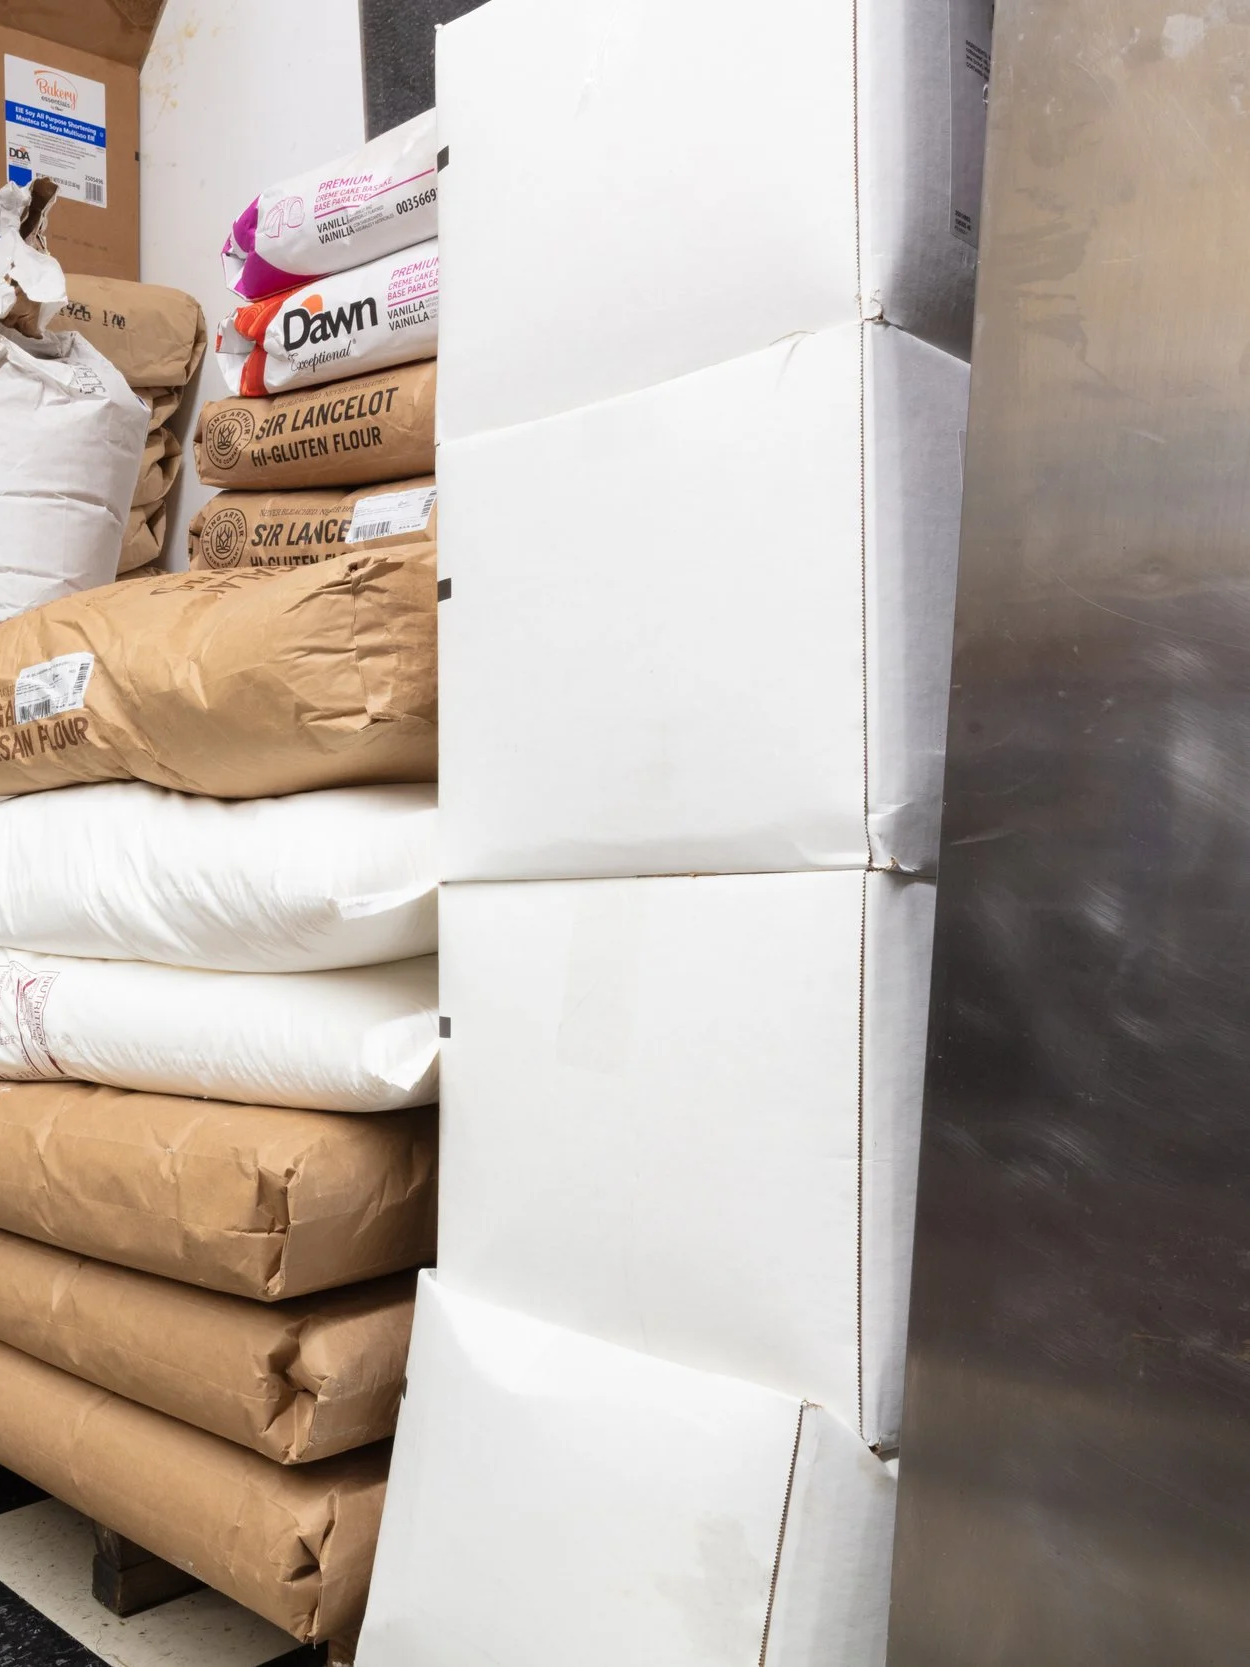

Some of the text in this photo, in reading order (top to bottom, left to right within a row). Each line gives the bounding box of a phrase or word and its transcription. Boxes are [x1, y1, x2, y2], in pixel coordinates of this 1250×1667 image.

[36, 78, 76, 111] Bakery
[41, 96, 71, 108] essentials
[15, 114, 40, 127] Manteca
[49, 122, 63, 132] Soya
[63, 127, 87, 140] Multiuso
[25, 108, 36, 118] Soy
[45, 114, 67, 127] Purpose
[68, 120, 97, 135] Shortening
[9, 147, 31, 162] DDA
[315, 191, 338, 203] CREME
[340, 187, 360, 197] CAKE
[318, 174, 373, 192] PREMIUM
[313, 201, 331, 213] BASE
[331, 196, 351, 206] PARA
[395, 187, 438, 215] 0035669
[387, 287, 406, 301] BASE
[407, 282, 427, 294] PARA
[388, 276, 414, 291] CREME
[414, 269, 434, 283] CAKE
[387, 300, 425, 320] VANILLA
[389, 311, 430, 332] VAINILLA
[283, 297, 378, 351] Dawn
[288, 340, 352, 373] Exceptional
[208, 411, 251, 435] KING ARTHUR
[255, 387, 399, 441] SIR LANCELOT
[251, 426, 383, 467] HI-GLUTEN FLOUR
[205, 511, 244, 537] KING ARTHUR
[251, 518, 352, 547] SIR LANCE
[37, 716, 90, 754] FLOUR
[34, 976, 54, 1046] NUTRITION
